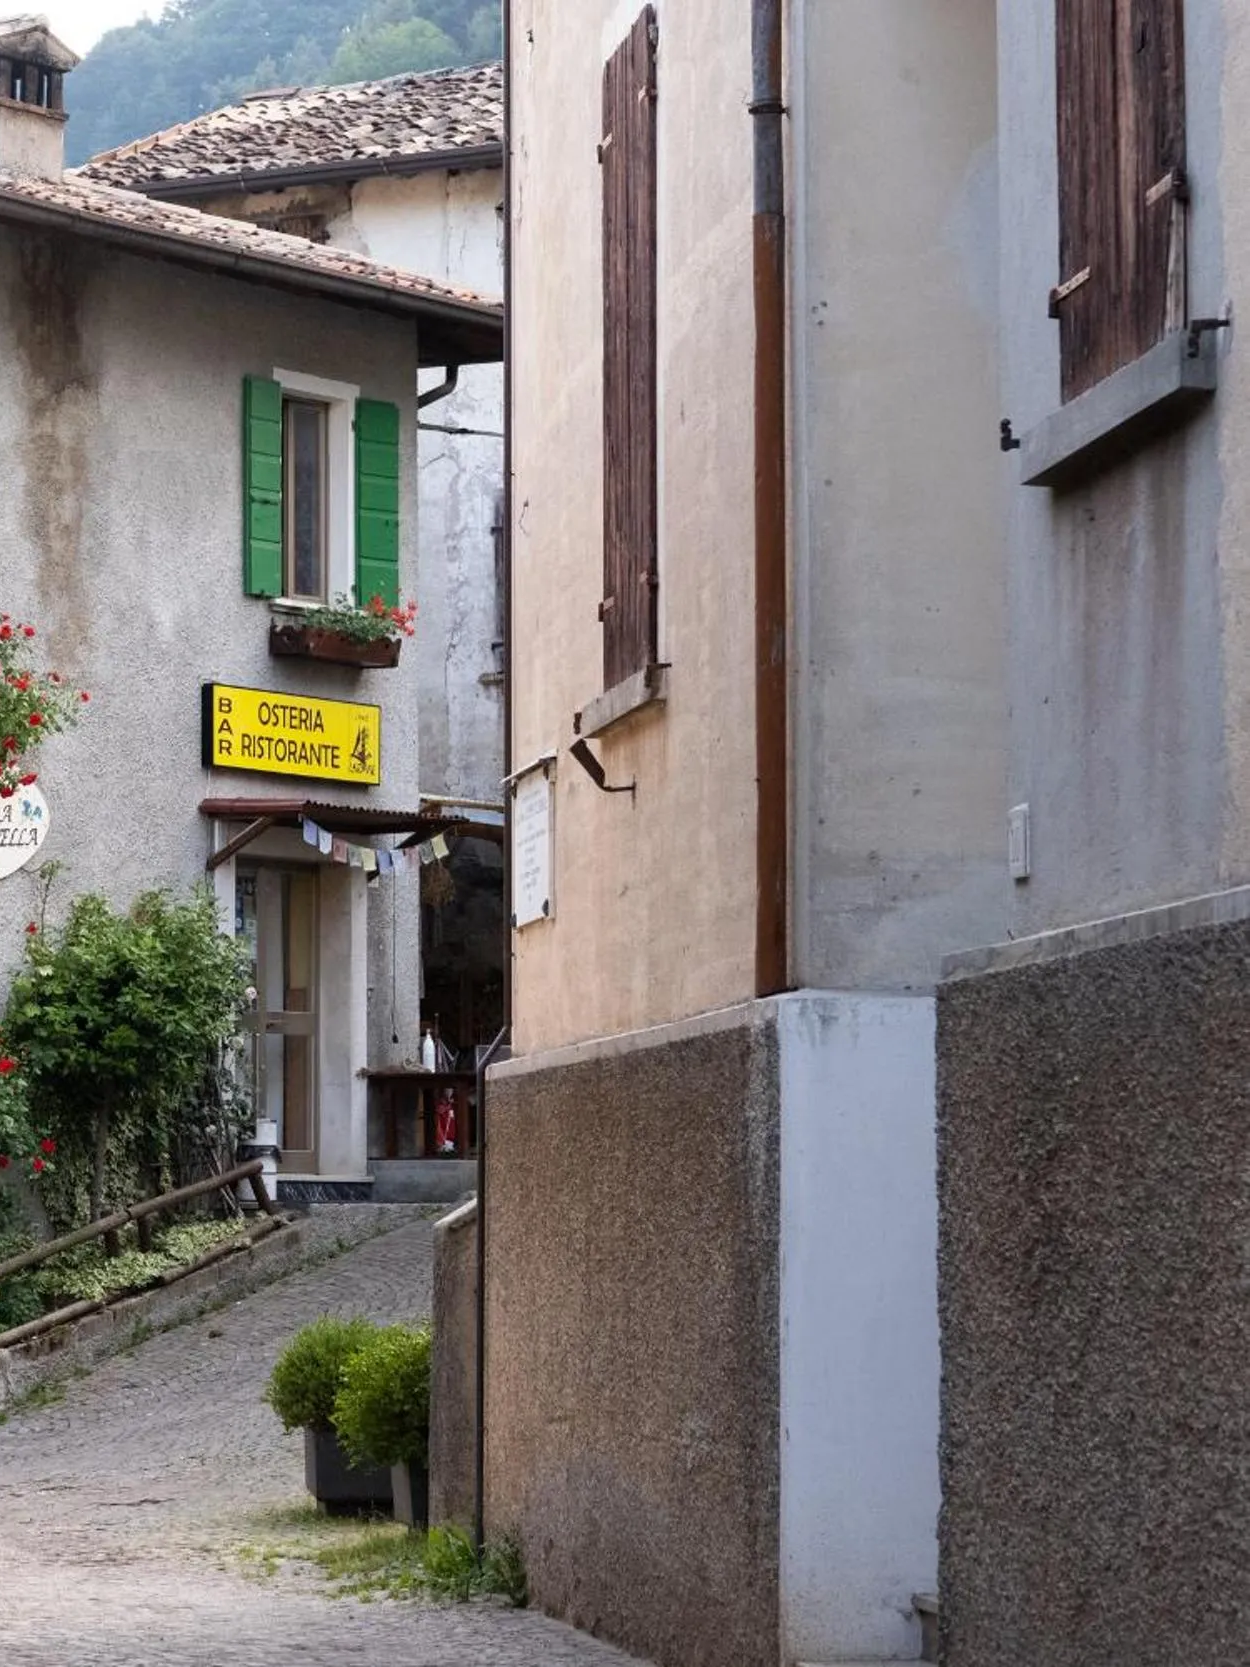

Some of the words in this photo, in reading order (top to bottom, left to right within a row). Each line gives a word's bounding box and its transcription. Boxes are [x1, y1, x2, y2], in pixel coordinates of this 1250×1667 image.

[218, 696, 233, 756] BAR
[258, 701, 325, 733] OSTERIA
[241, 733, 341, 769] RISTORANTE
